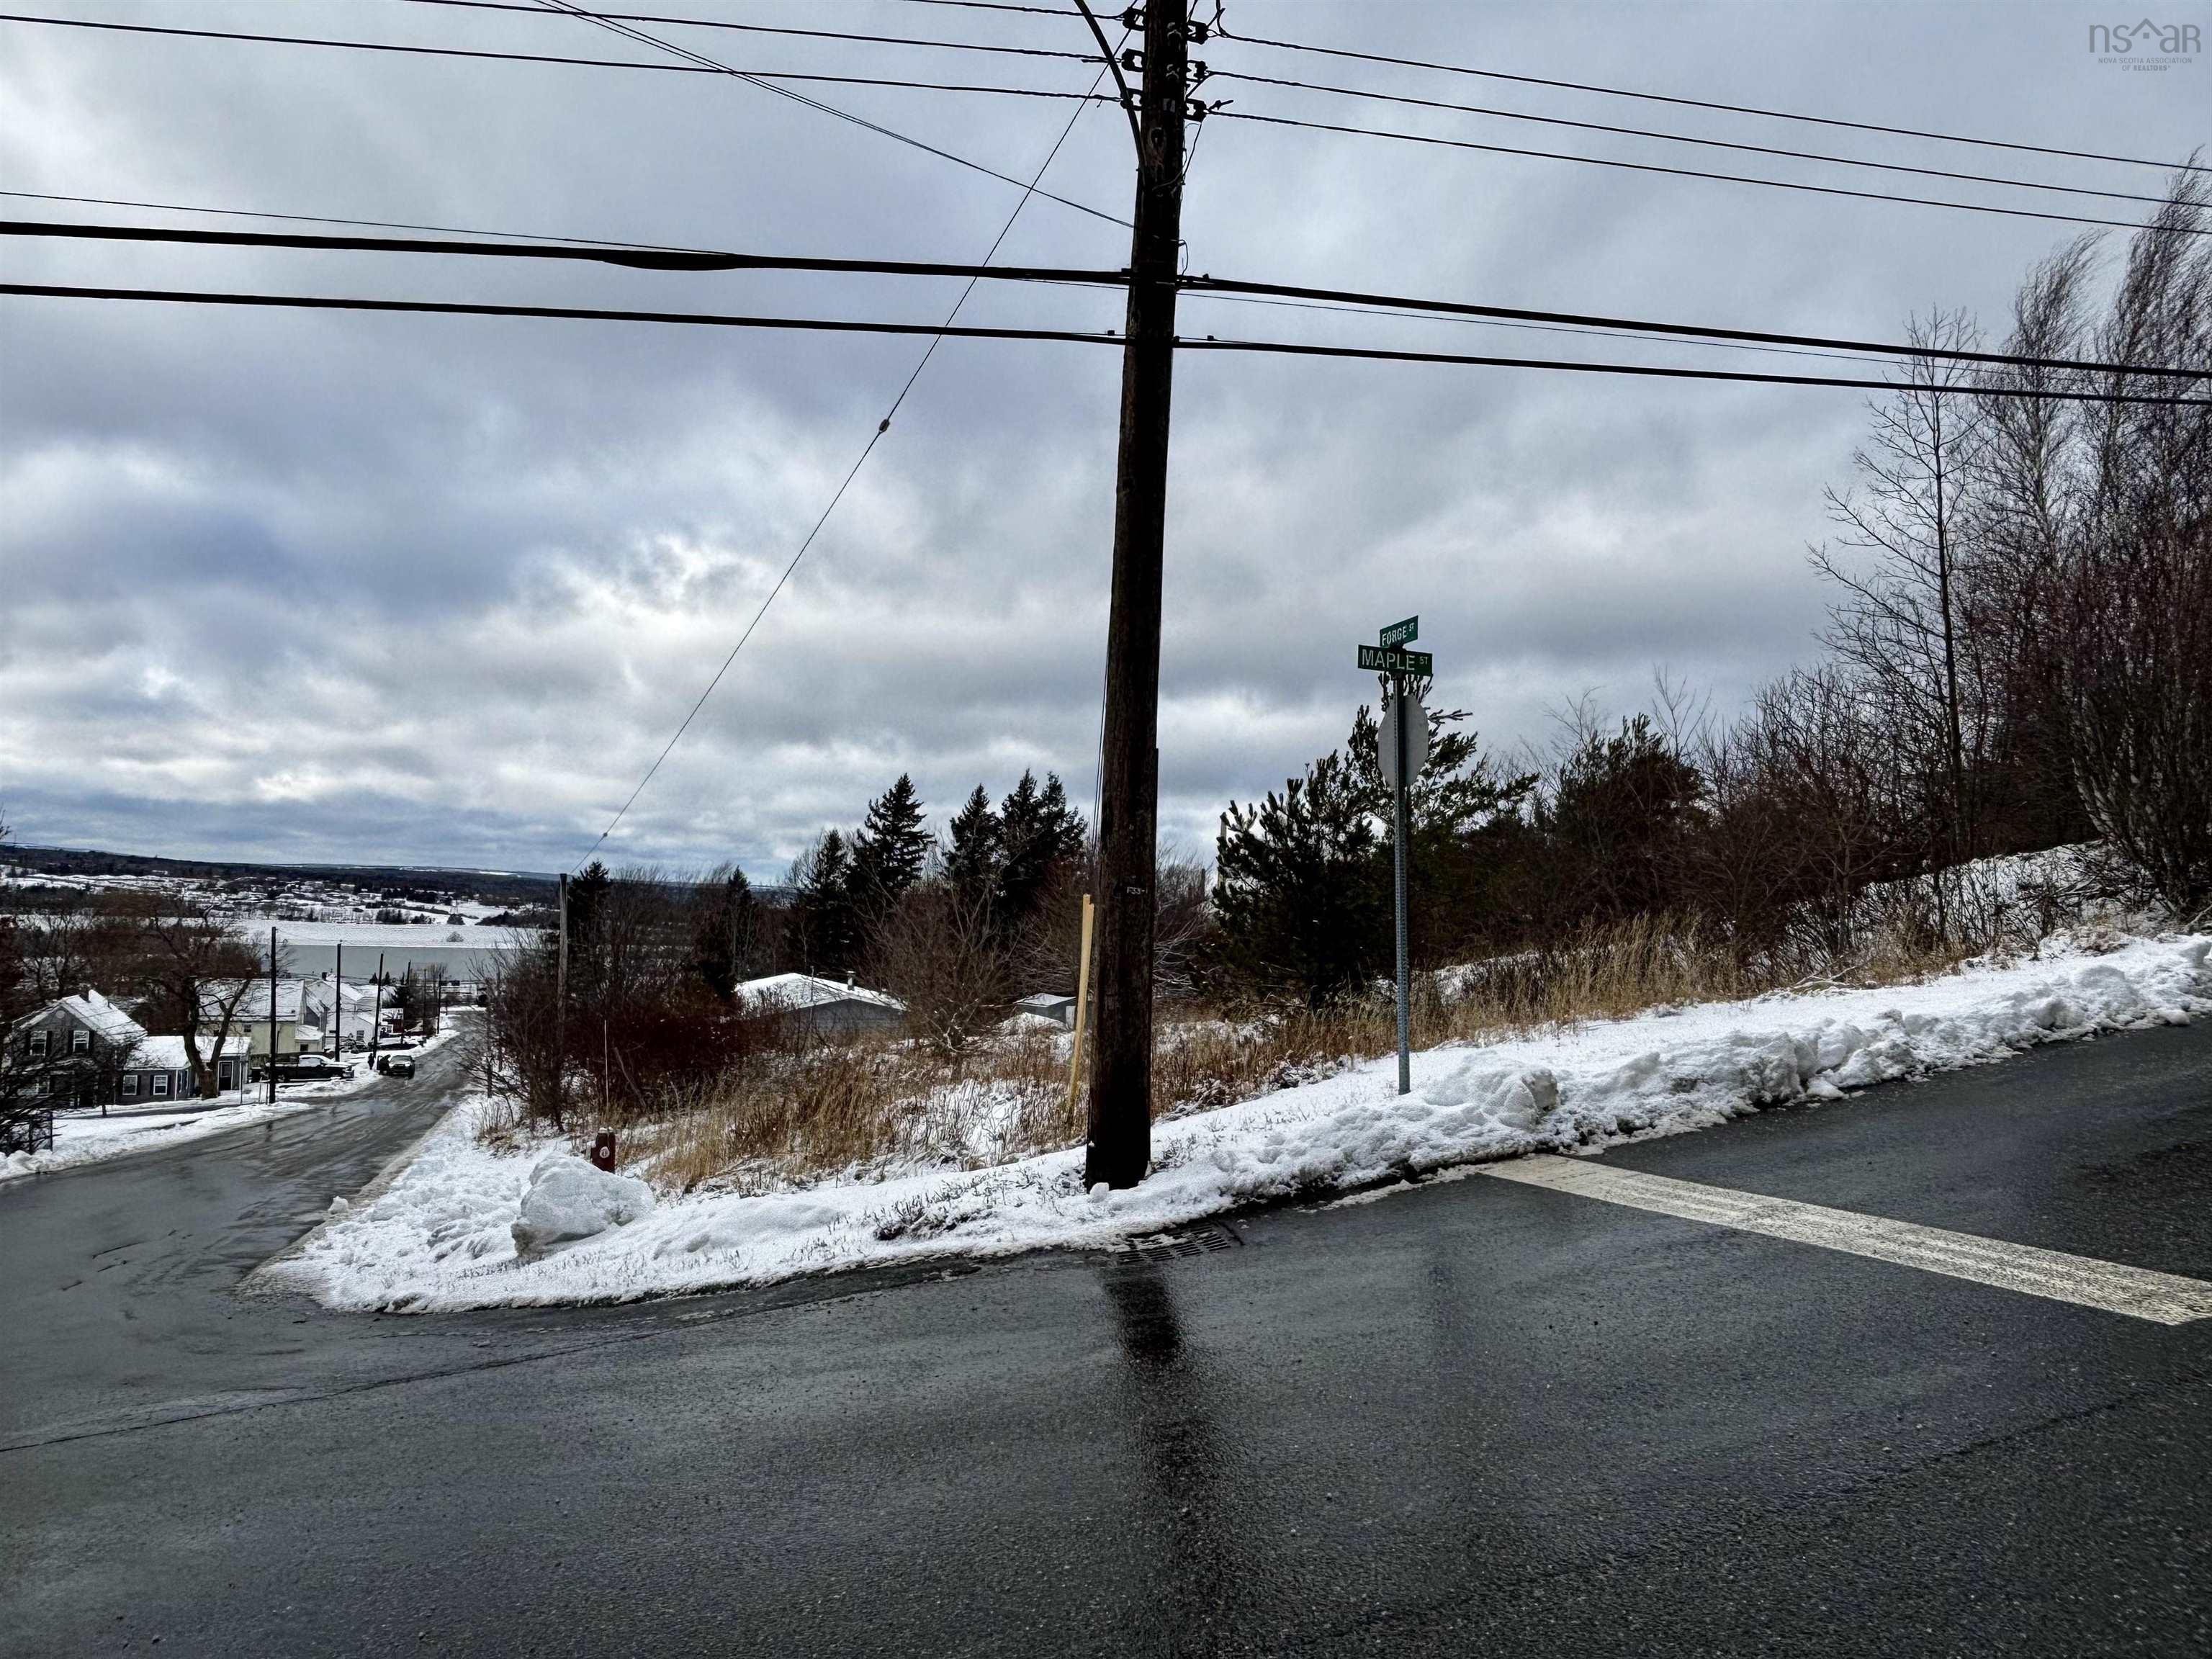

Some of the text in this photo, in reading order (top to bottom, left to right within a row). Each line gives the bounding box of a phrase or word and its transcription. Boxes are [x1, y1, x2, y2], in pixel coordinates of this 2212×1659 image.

[1382, 622, 1415, 646] FORGE ST
[1362, 649, 1429, 670] MAPLE ST
